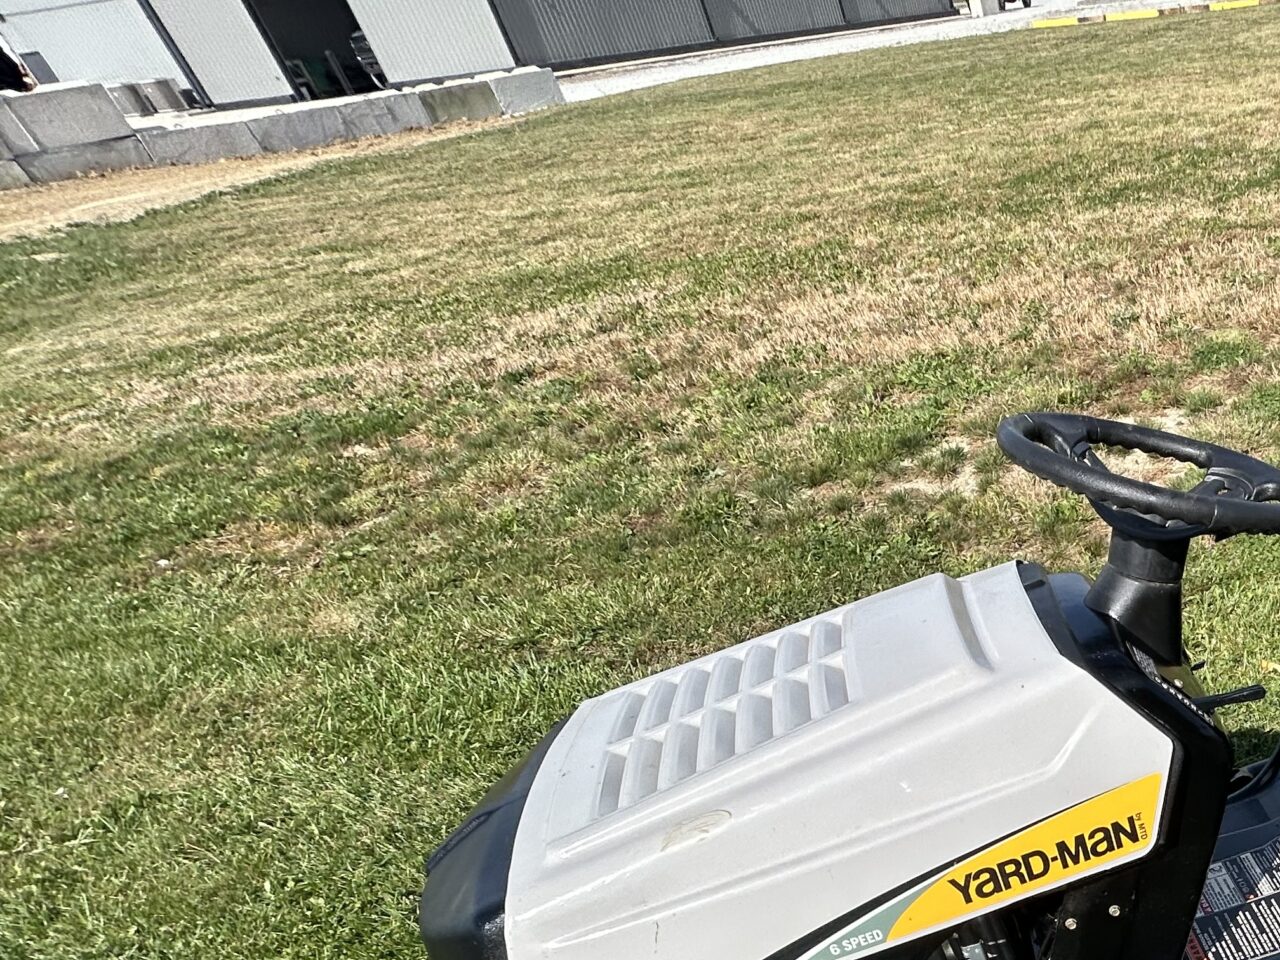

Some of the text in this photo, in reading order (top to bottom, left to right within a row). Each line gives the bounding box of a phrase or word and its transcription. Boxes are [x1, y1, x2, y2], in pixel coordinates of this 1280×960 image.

[1138, 823, 1148, 840] MTD
[829, 929, 883, 956] 6 SPEED
